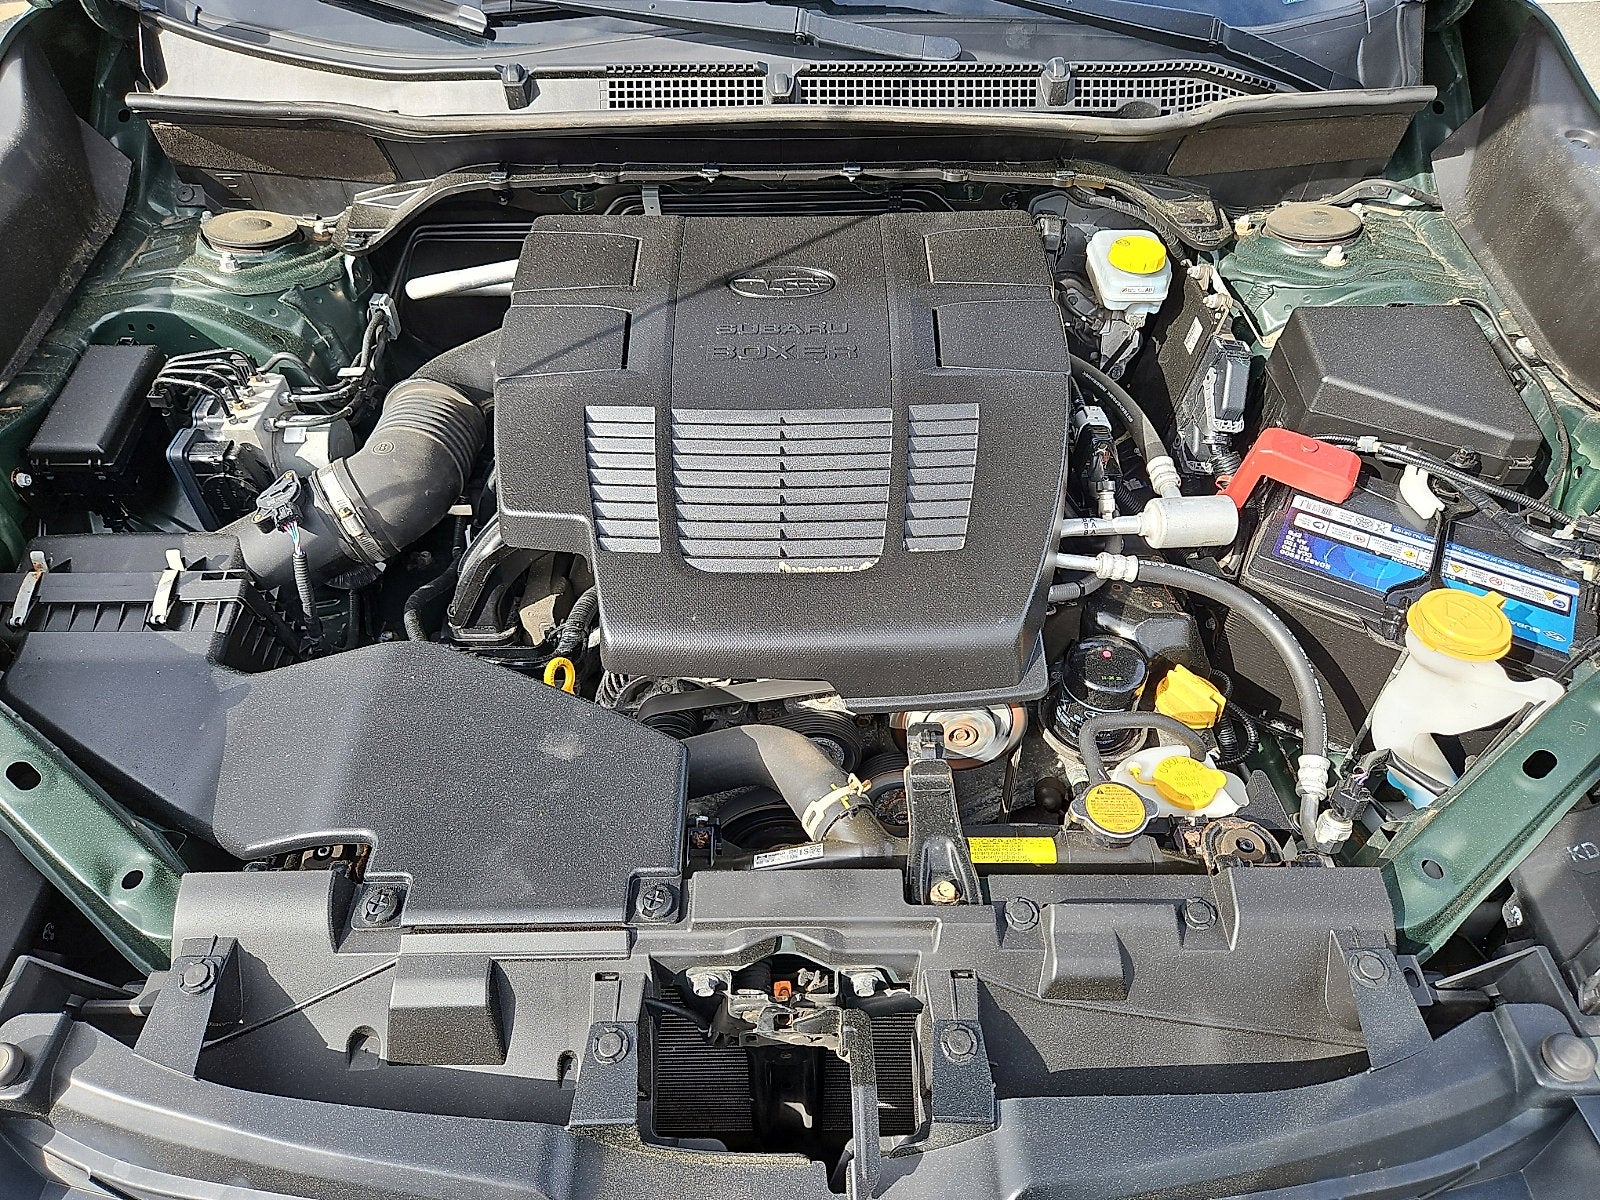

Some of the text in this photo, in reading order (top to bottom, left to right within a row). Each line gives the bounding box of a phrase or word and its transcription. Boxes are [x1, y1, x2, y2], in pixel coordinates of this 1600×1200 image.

[715, 322, 850, 336] SUBARU
[713, 342, 859, 360] BOXER
[1297, 549, 1313, 558] CCA
[1509, 619, 1541, 634] SUBA
